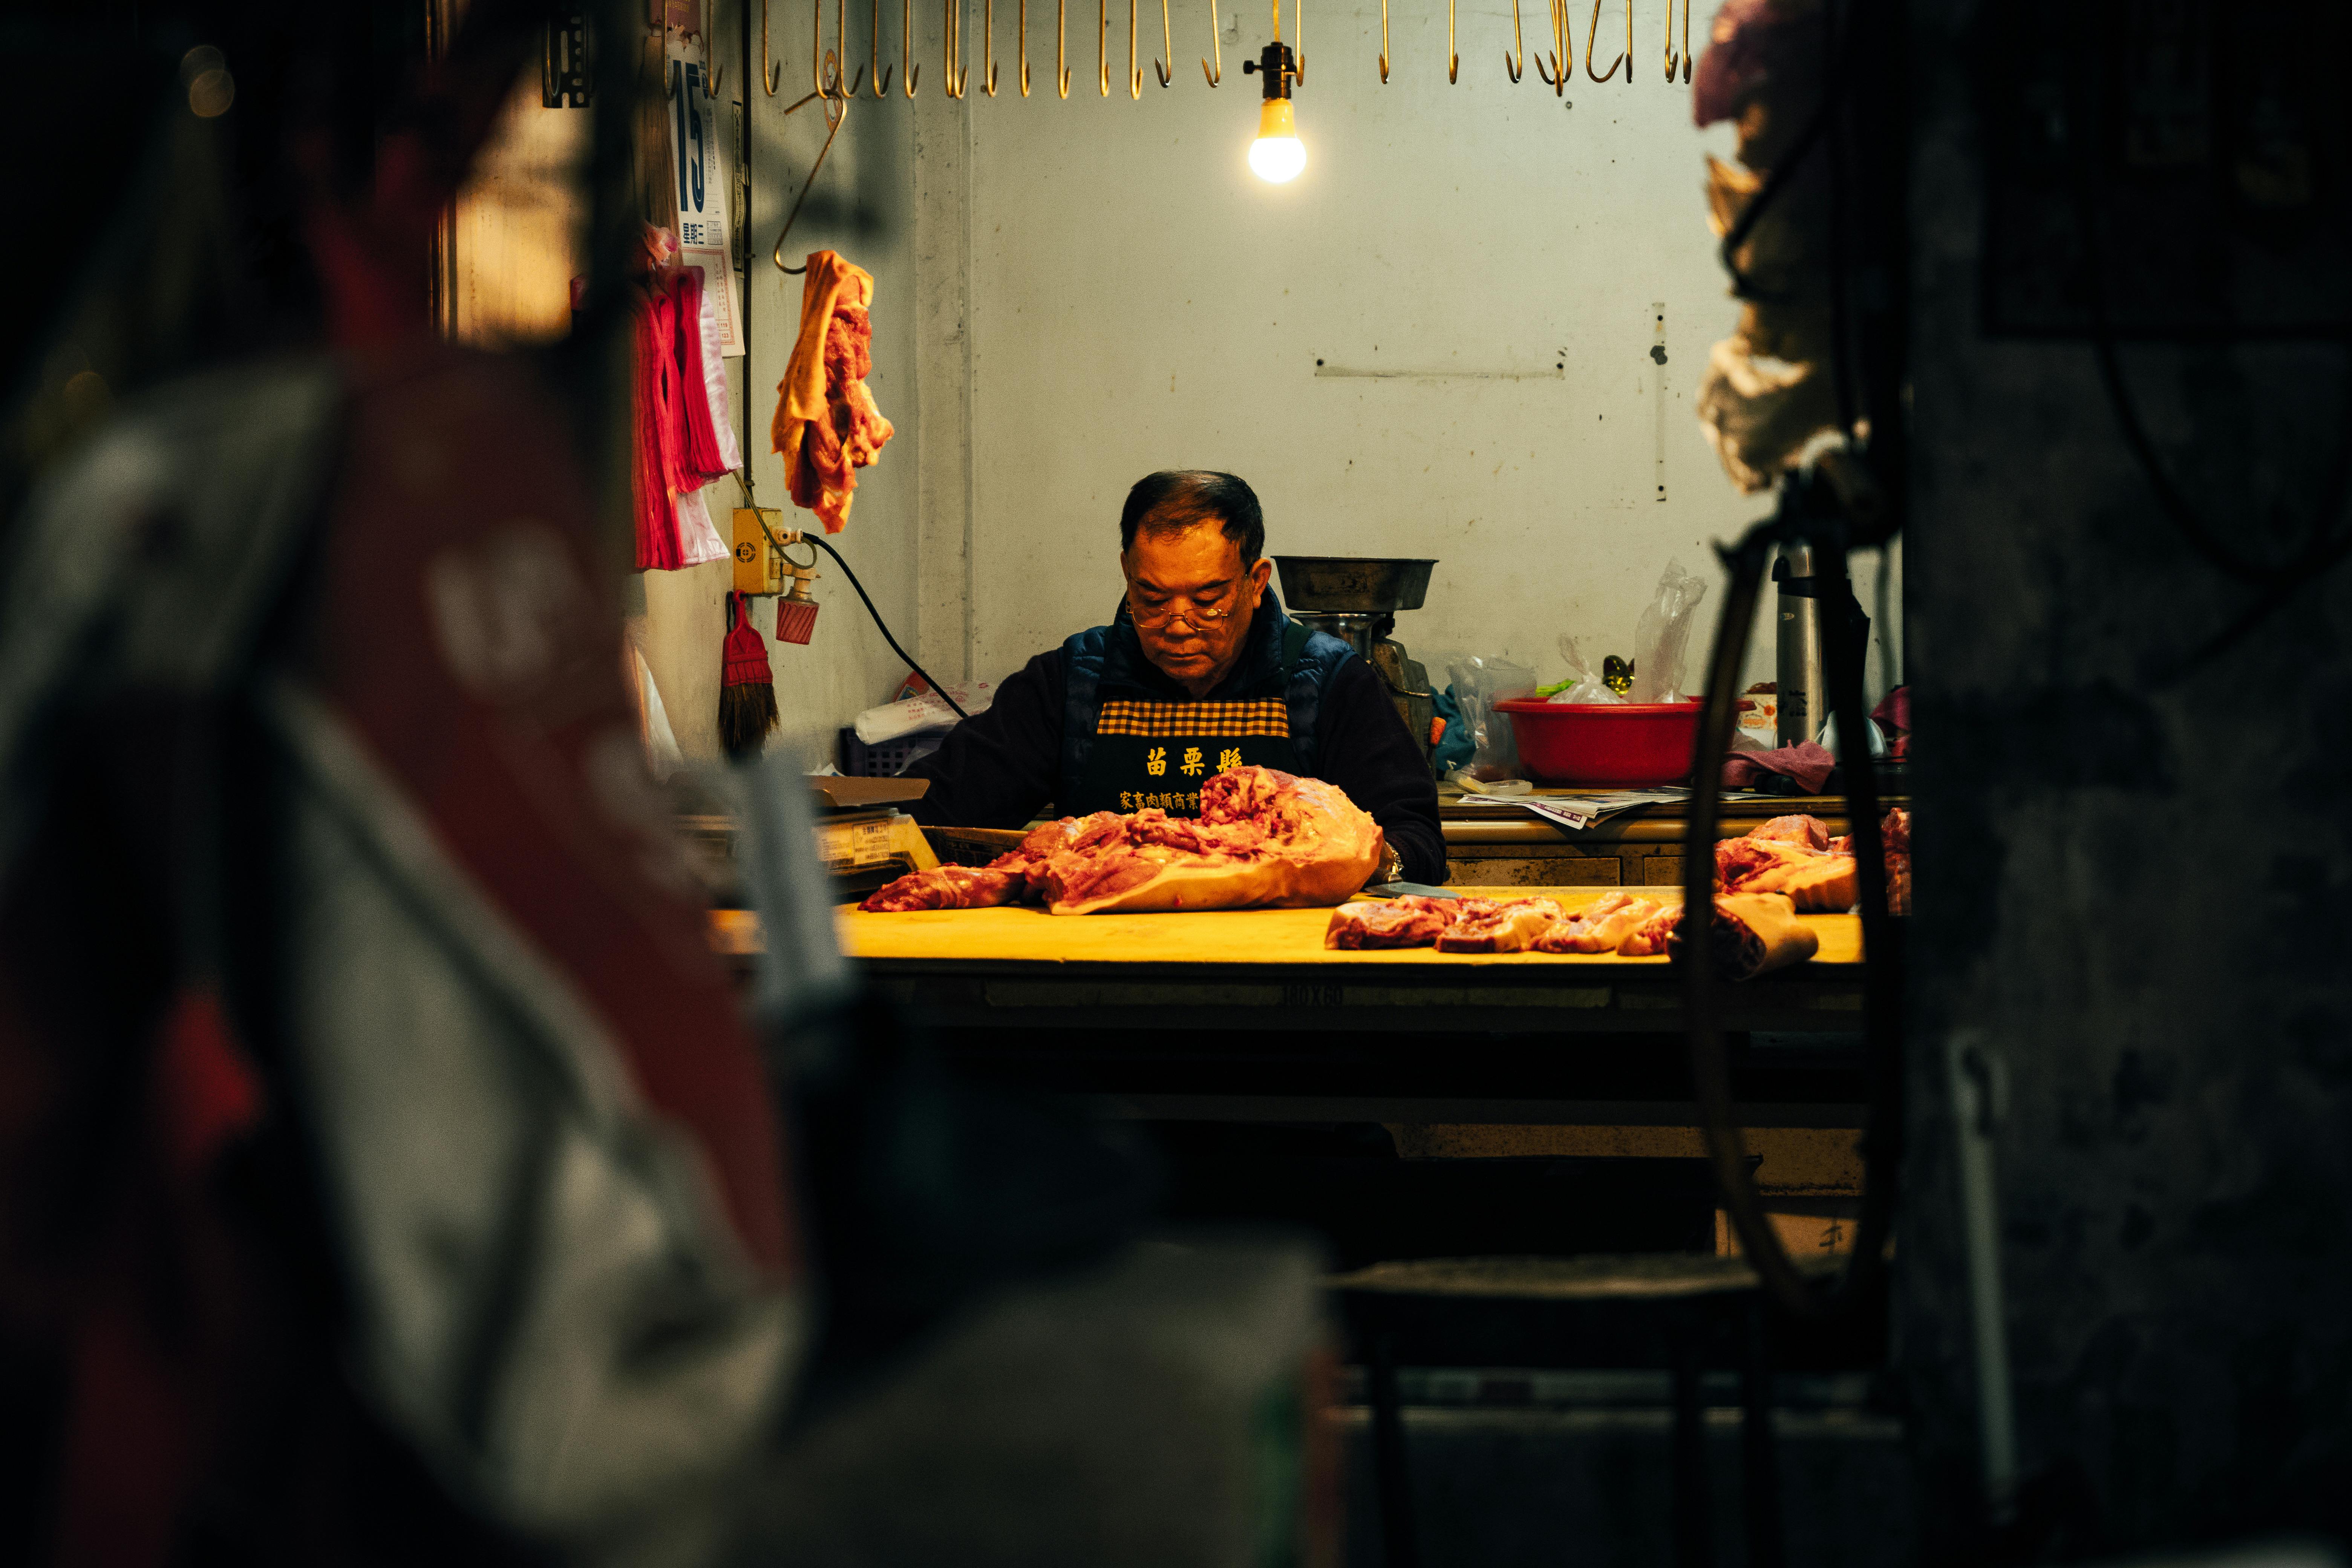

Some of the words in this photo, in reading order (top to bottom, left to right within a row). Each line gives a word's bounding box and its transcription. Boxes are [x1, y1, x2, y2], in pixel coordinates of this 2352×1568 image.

[673, 60, 704, 213] 15
[683, 223, 704, 245] 星期三
[1147, 747, 1242, 776] 苗栗縣
[1120, 791, 1199, 810] 家畜肉類商業
[1283, 985, 1343, 1006] 180X60
